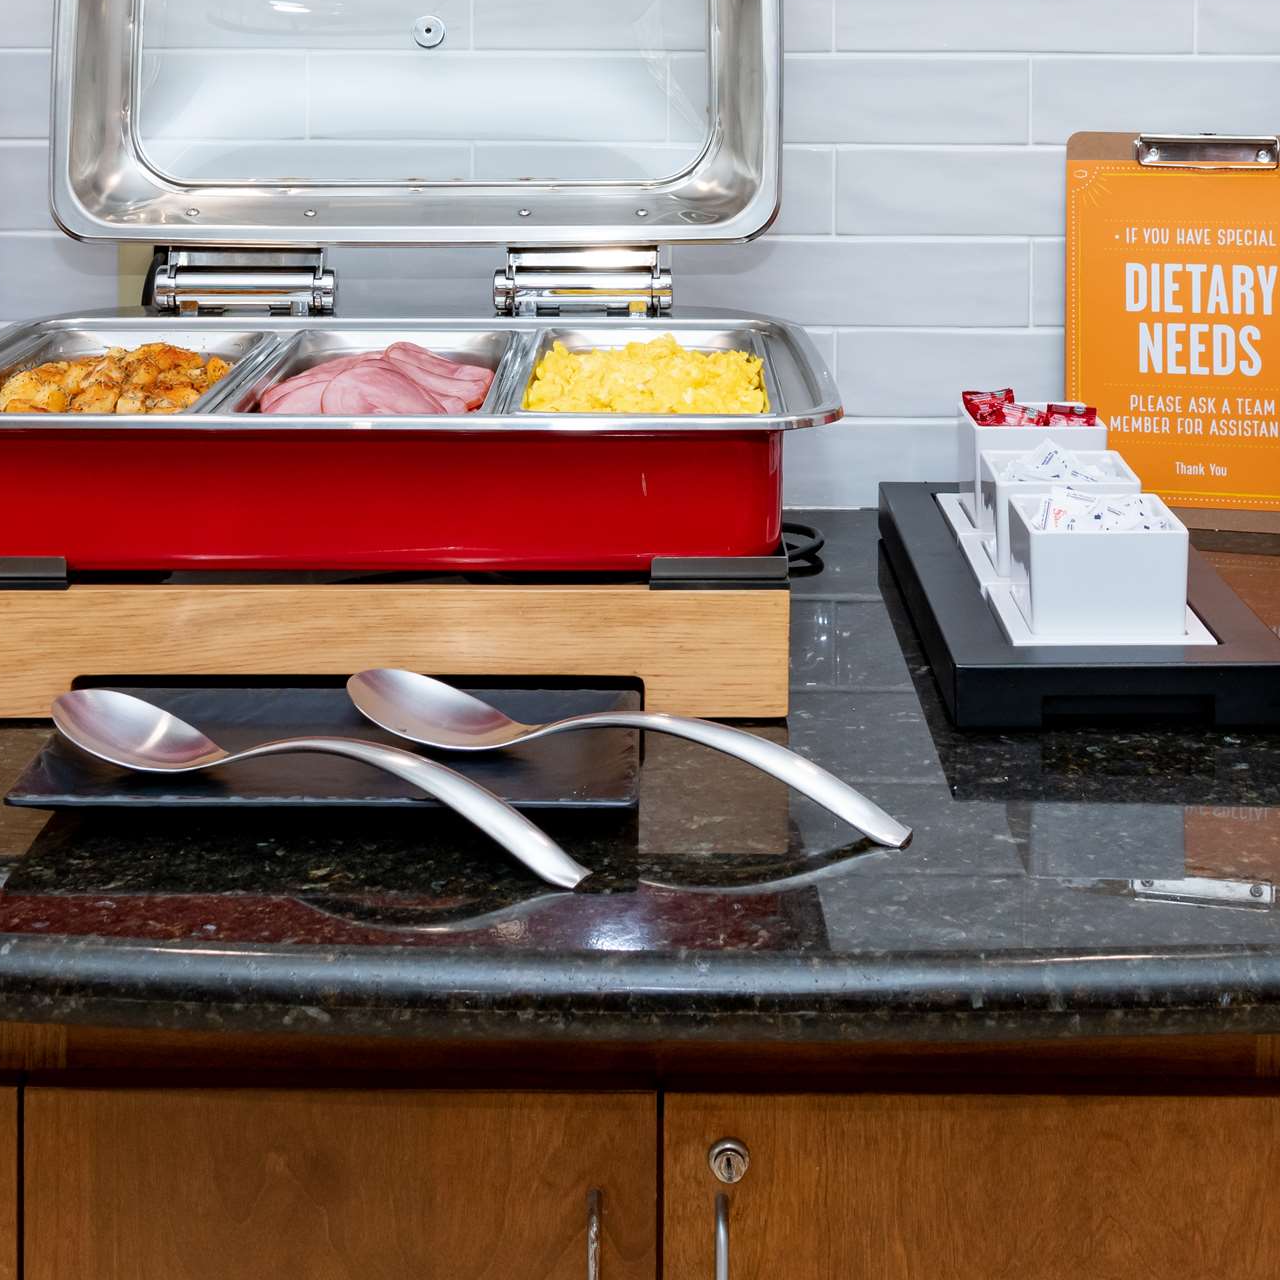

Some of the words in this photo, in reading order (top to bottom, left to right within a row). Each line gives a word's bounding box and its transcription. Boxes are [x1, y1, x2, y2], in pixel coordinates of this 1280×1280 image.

[1125, 226, 1138, 244] IF
[1143, 227, 1170, 245] YOU
[1176, 227, 1211, 246] HAVE
[1217, 228, 1276, 247] SPECIAL
[1125, 262, 1278, 316] DIETARY
[1138, 321, 1263, 377] NEEDS
[1129, 394, 1182, 414] PLEASE
[1188, 396, 1216, 414] ASK
[1221, 398, 1231, 415] A
[1236, 397, 1276, 416] TEAM
[1109, 415, 1170, 434] MEMBER
[1176, 417, 1203, 435] FOR
[1175, 461, 1205, 476] Thank
[1209, 463, 1228, 477] You
